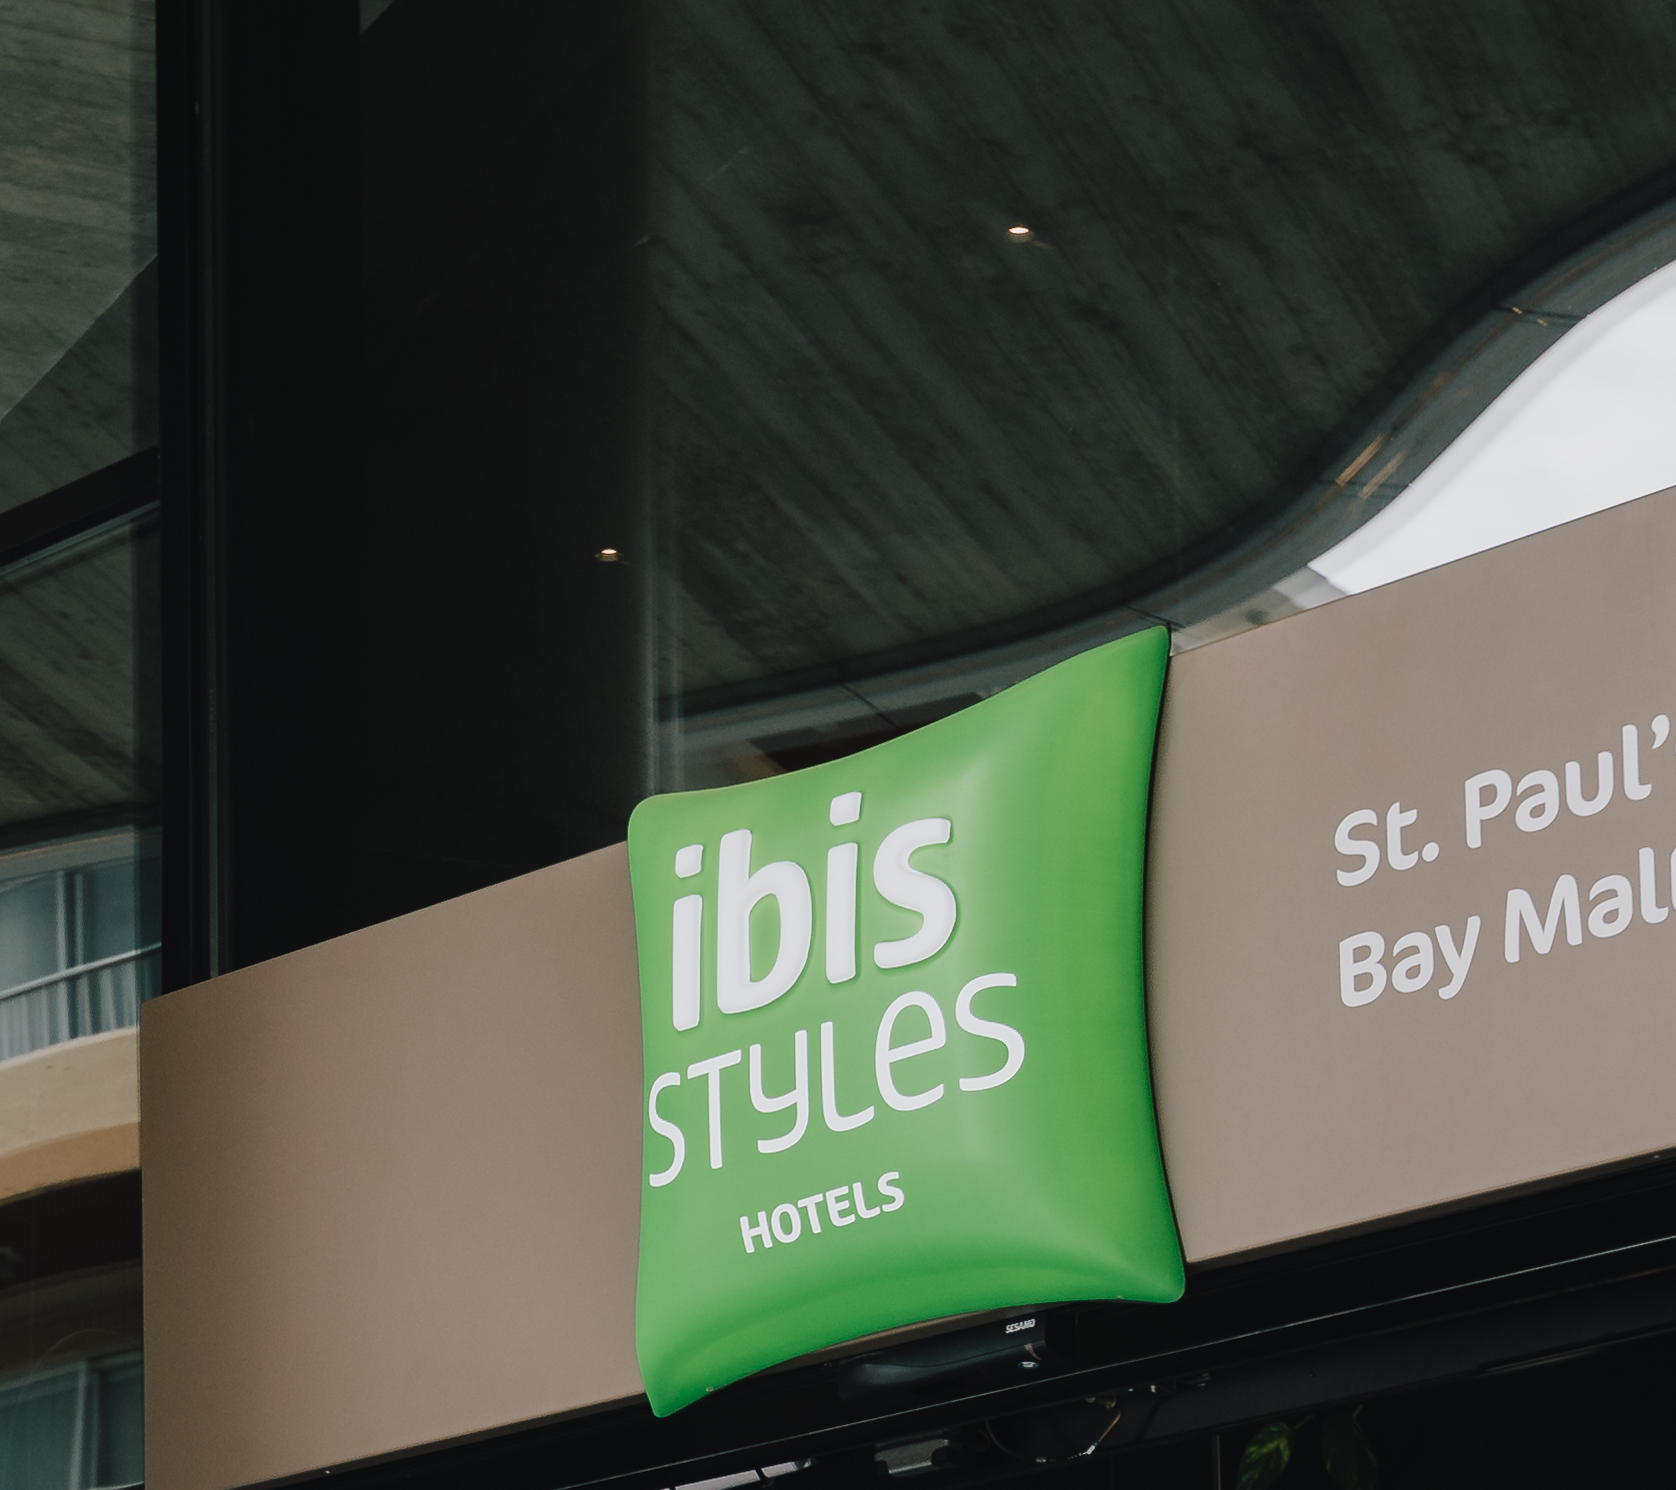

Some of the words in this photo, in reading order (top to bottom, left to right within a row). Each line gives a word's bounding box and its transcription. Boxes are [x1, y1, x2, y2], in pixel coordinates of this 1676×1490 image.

[1333, 801, 1441, 888] St.
[670, 790, 960, 1034] ibis
[1338, 914, 1482, 1008] Bay
[739, 1169, 906, 1255] HOTELS
